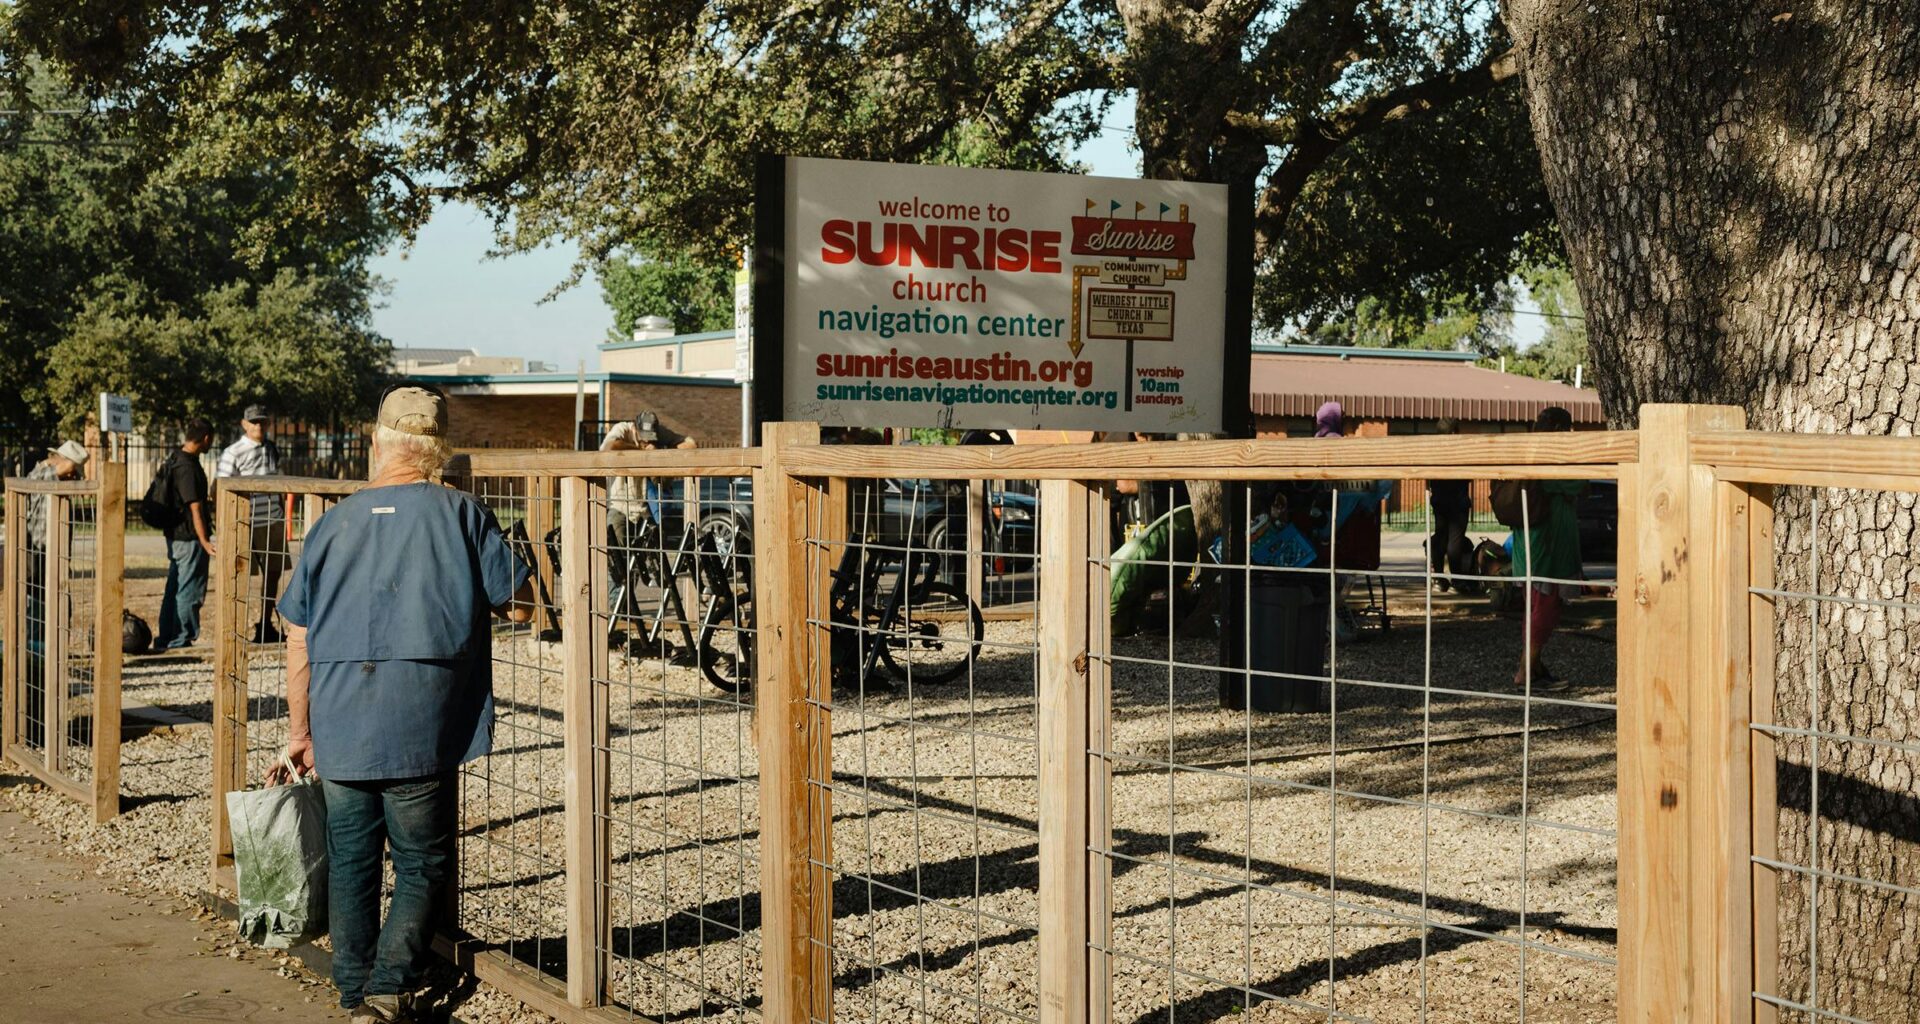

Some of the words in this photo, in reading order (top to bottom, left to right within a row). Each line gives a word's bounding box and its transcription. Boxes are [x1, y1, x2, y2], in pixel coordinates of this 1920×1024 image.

[878, 196, 981, 221] welcome
[987, 203, 1010, 222] to
[1084, 221, 1175, 251] Sunrise
[821, 219, 1062, 274] SUNRISE
[1104, 262, 1160, 273] COMMUNITY
[1113, 274, 1151, 284] CHURCH
[892, 273, 987, 303] church
[1092, 294, 1137, 307] WEIRDEST
[1139, 296, 1169, 308] LITTLE
[818, 305, 968, 338] navigation
[977, 313, 1065, 337] center
[1107, 308, 1141, 321] CHURCH
[1144, 310, 1154, 321] IN
[1116, 322, 1144, 334] TEXAS
[816, 348, 1093, 388] sunriseaustin.org
[1136, 366, 1185, 380] worship
[1140, 378, 1180, 393] 10am
[816, 380, 1118, 409] sunrisenavigationcenter.org
[1135, 393, 1184, 406] sundays
